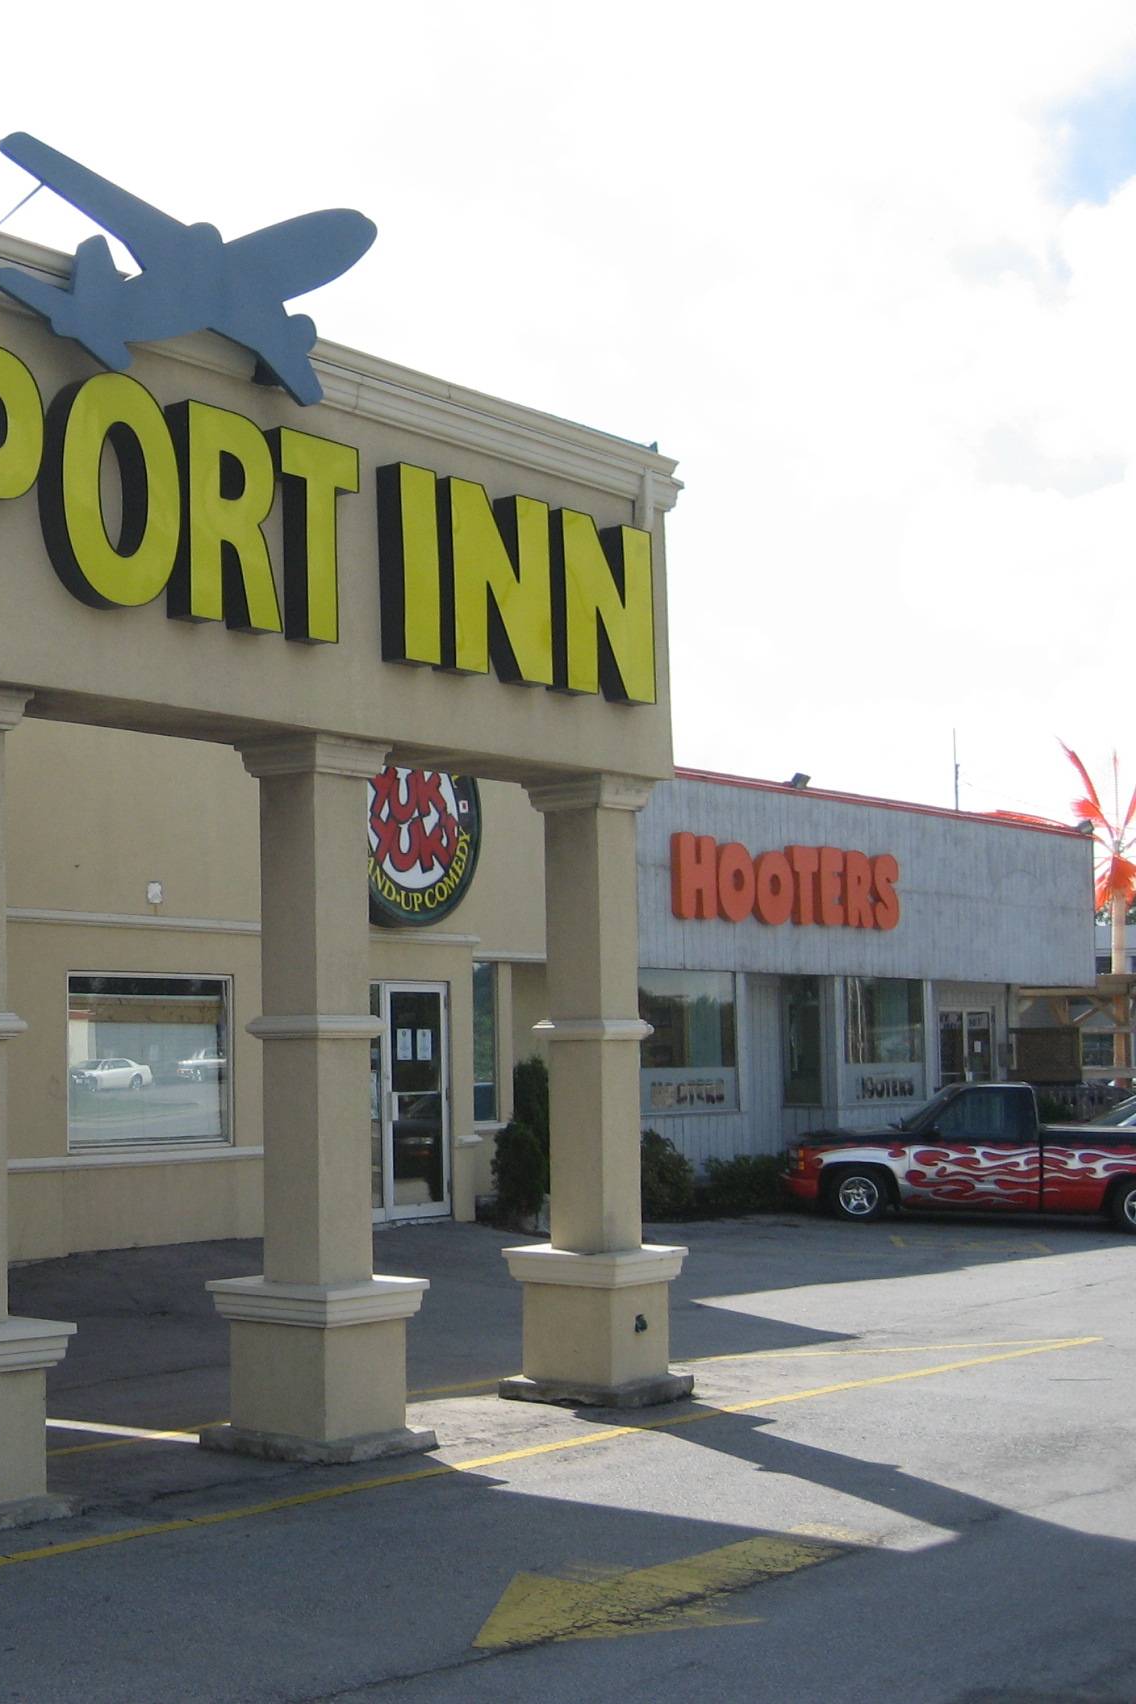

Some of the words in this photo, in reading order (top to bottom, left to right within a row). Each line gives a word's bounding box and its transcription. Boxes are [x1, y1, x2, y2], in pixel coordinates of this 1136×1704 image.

[377, 461, 657, 705] INN
[370, 767, 448, 823] YUK
[368, 856, 423, 912] AND-UP
[424, 828, 472, 908] COMEDY
[670, 831, 900, 931] HOOTERS
